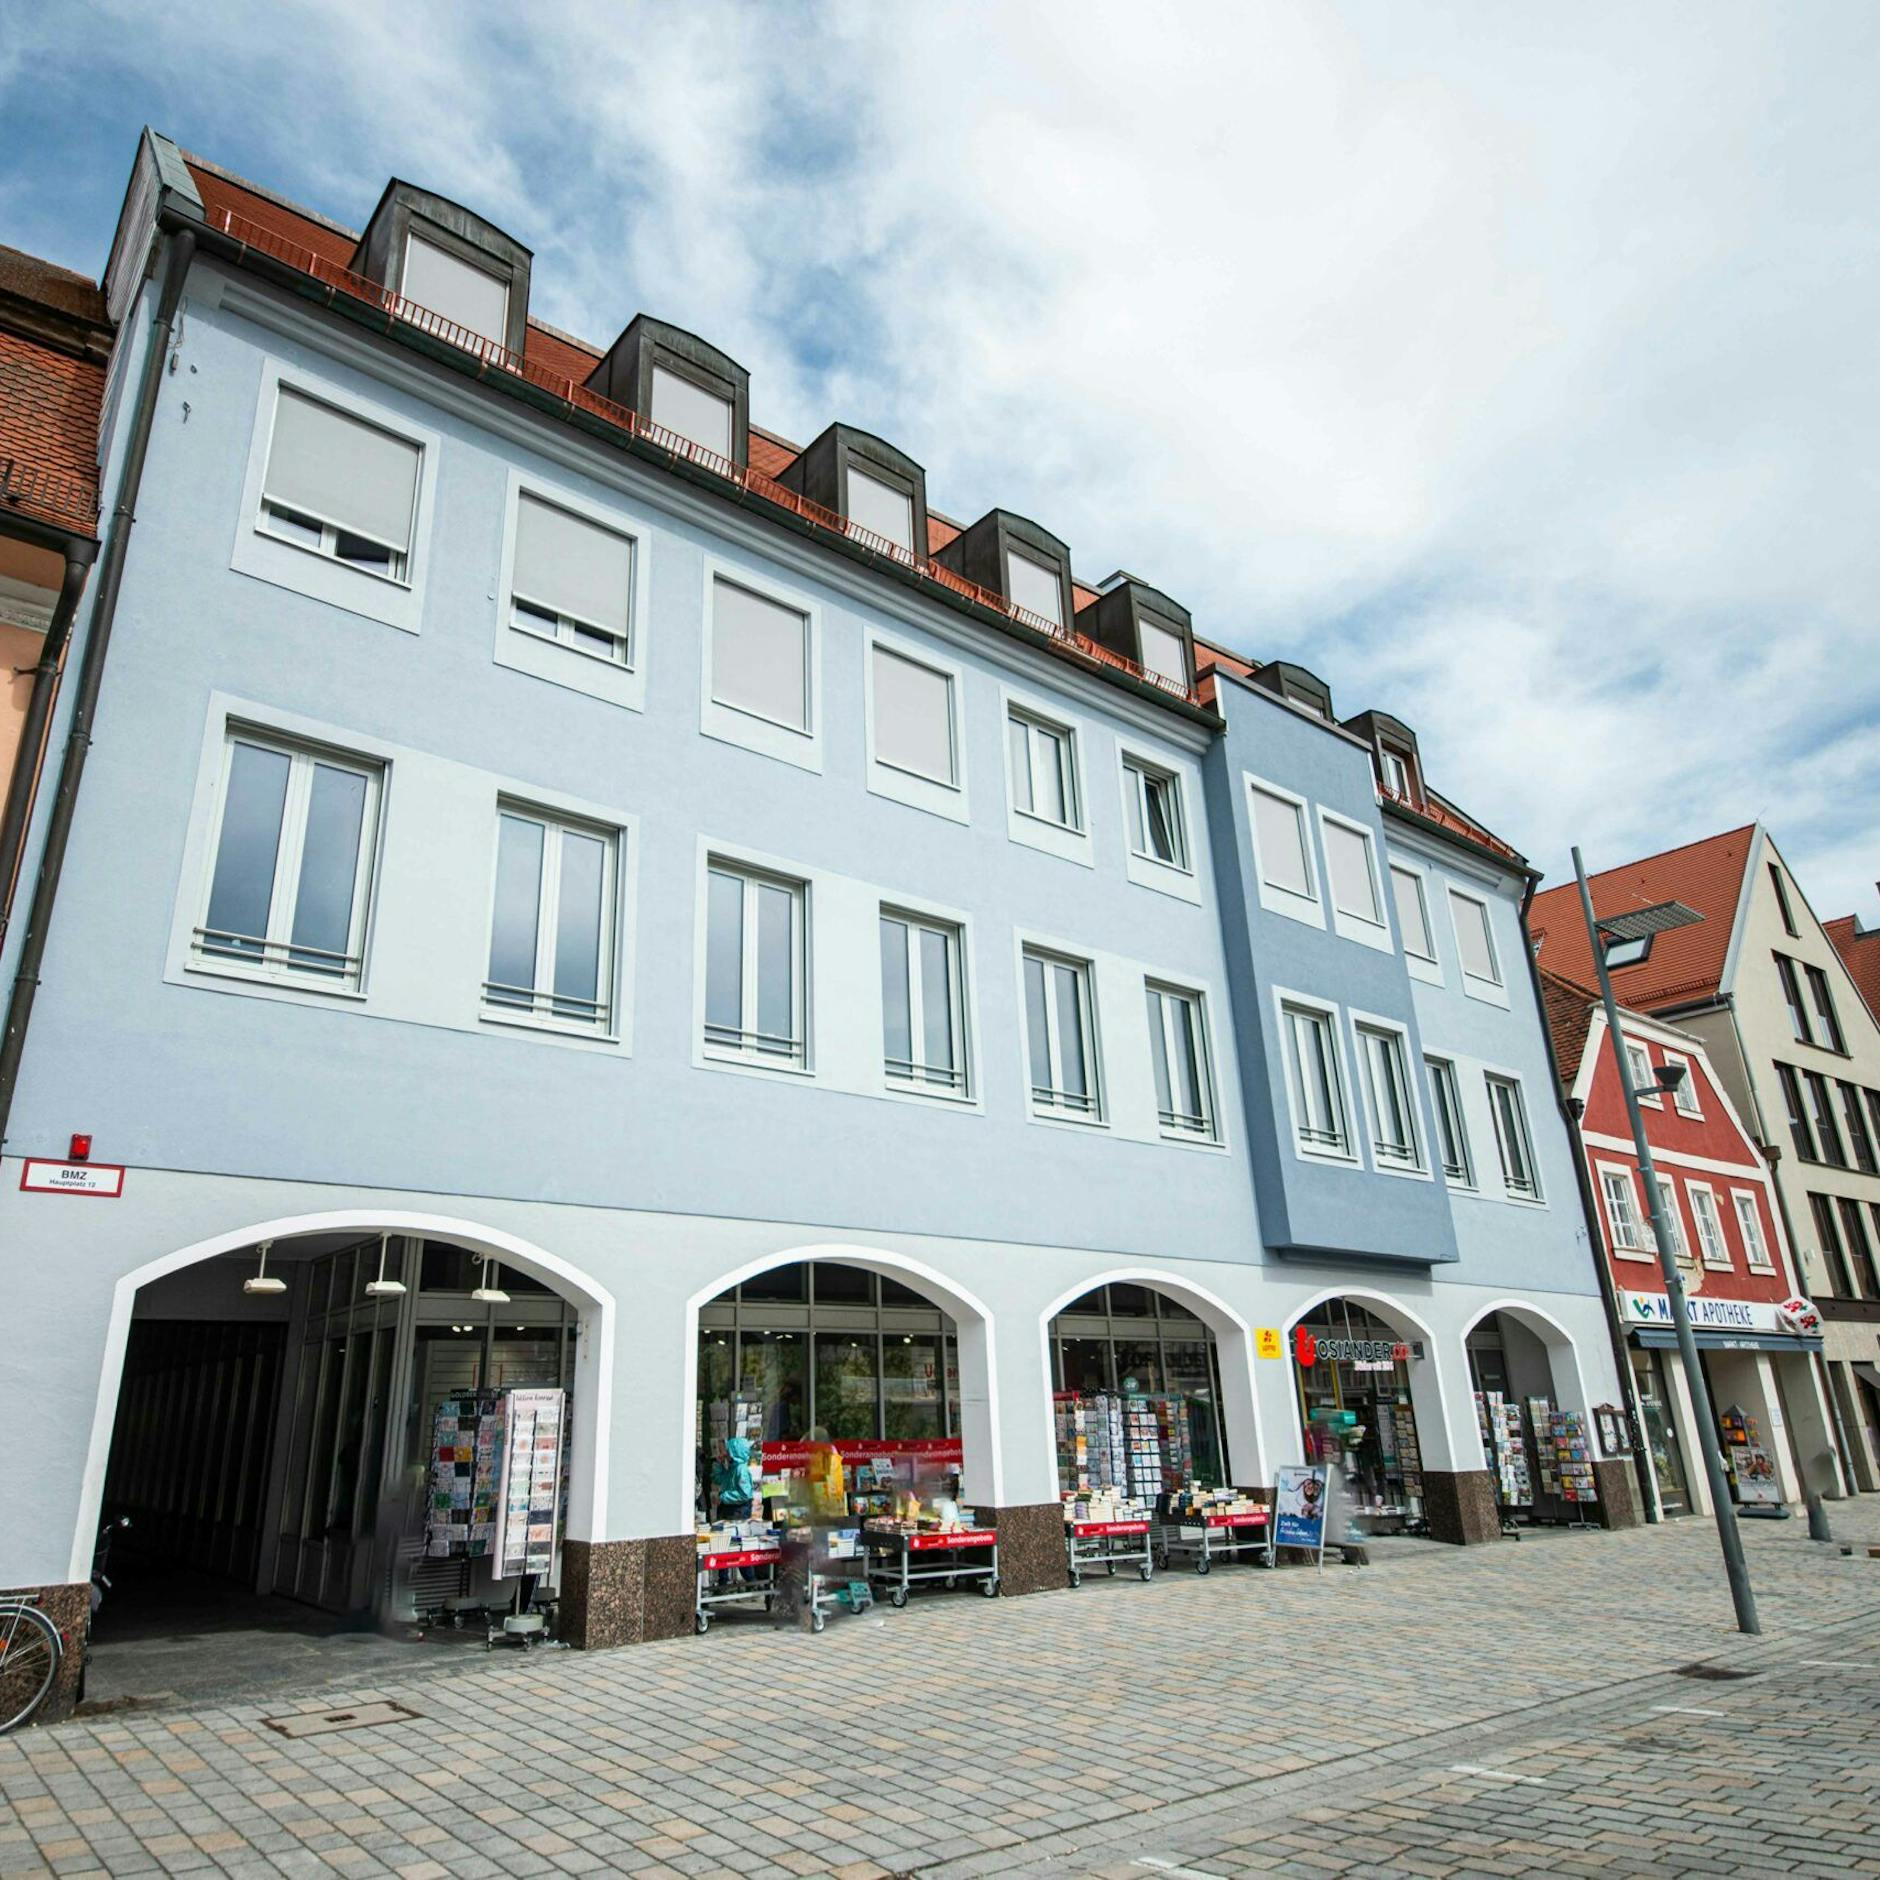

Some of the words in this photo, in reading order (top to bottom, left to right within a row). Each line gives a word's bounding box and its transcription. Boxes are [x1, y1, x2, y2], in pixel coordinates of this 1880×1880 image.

[61, 1169, 87, 1180] BMZ
[49, 1178, 86, 1187] Hauptplatz
[1658, 1298, 1698, 1321] MKT
[1702, 1302, 1753, 1325] APOTHEKE
